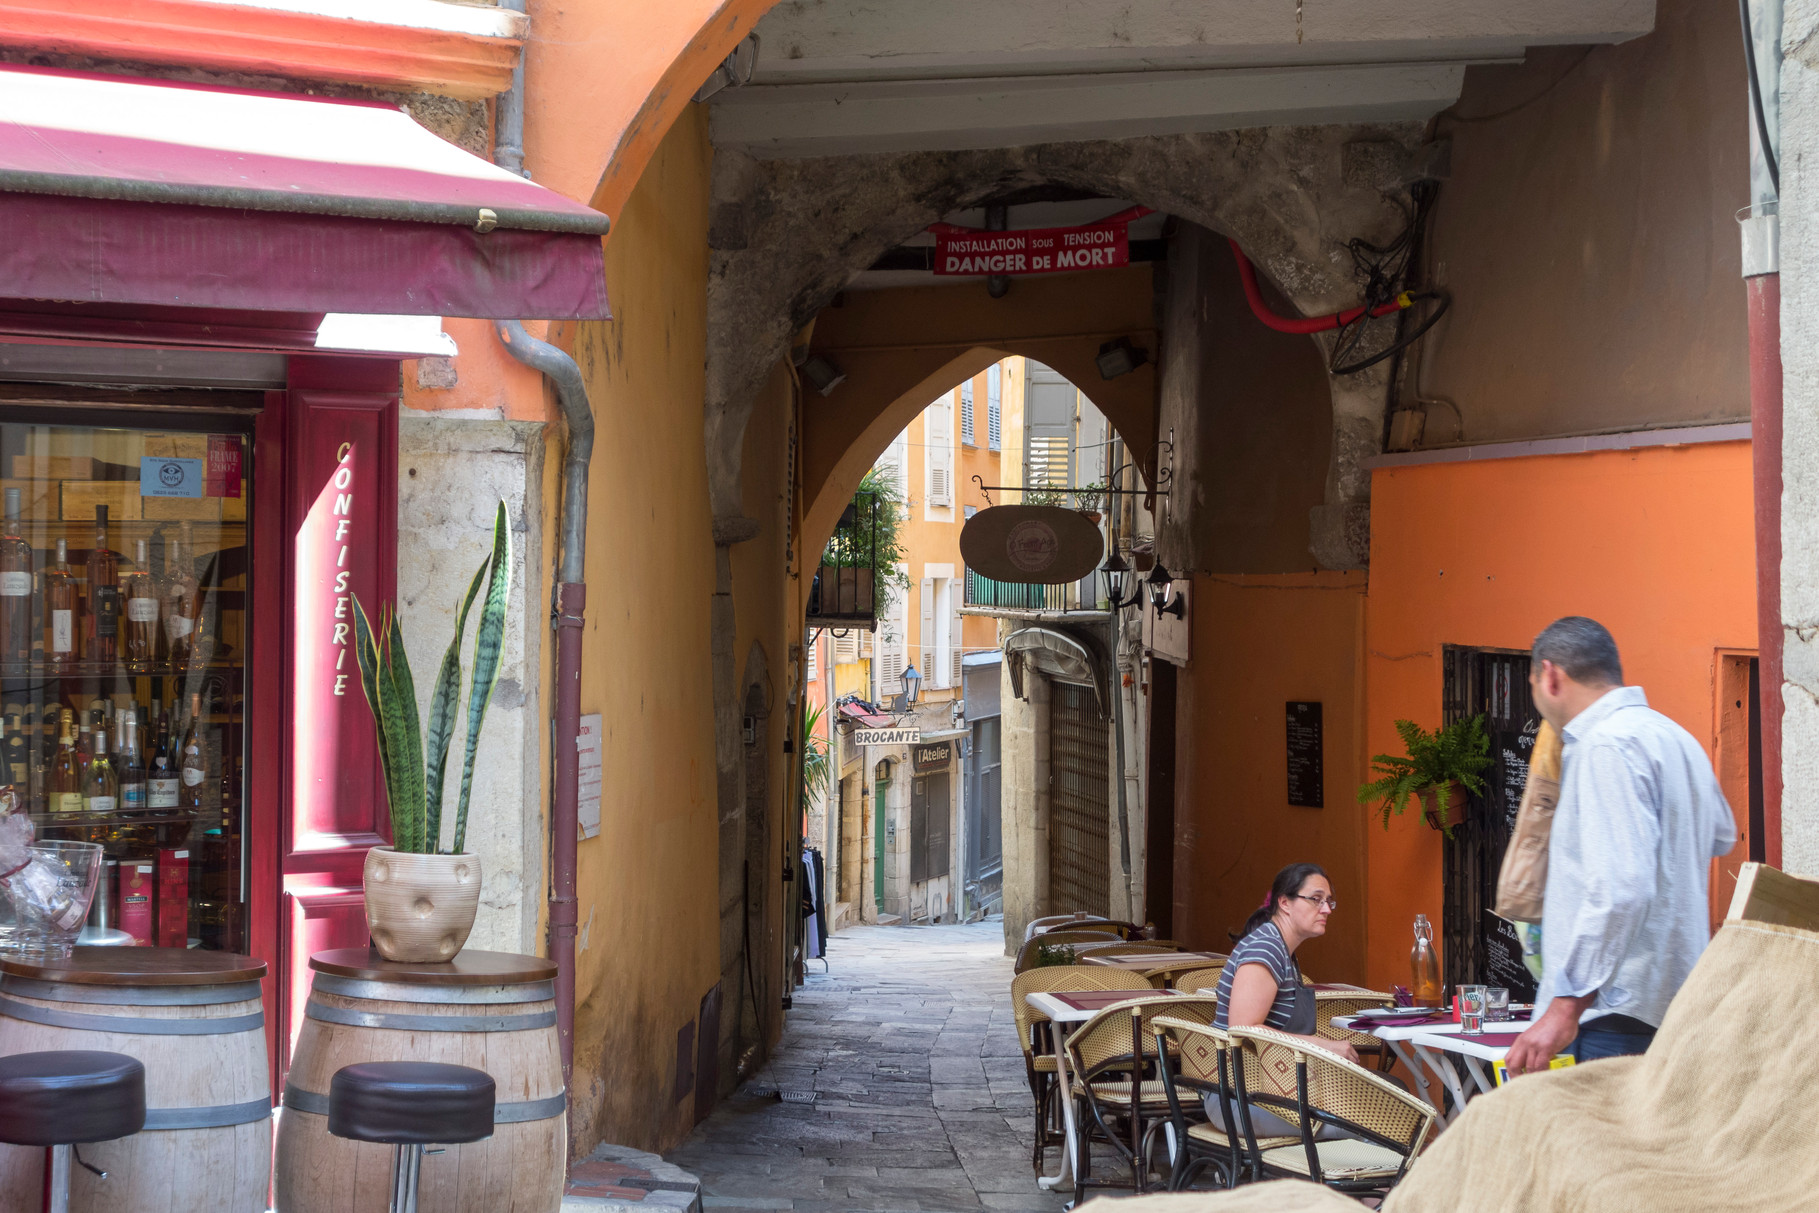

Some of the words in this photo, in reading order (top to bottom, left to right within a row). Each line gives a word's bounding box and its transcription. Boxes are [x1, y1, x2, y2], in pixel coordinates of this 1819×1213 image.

[947, 238, 1025, 252] INSTALLATION
[1032, 238, 1053, 248] SOUS
[1064, 231, 1114, 246] TENSION
[946, 254, 1027, 272] DANGER
[1032, 256, 1051, 269] DE
[1057, 247, 1116, 268] MORT
[209, 450, 239, 463] FRANCE
[211, 463, 237, 473] 2007
[333, 442, 352, 697] CONFISERIE
[855, 731, 919, 743] BROCANTE
[918, 747, 949, 763] l'Atelier
